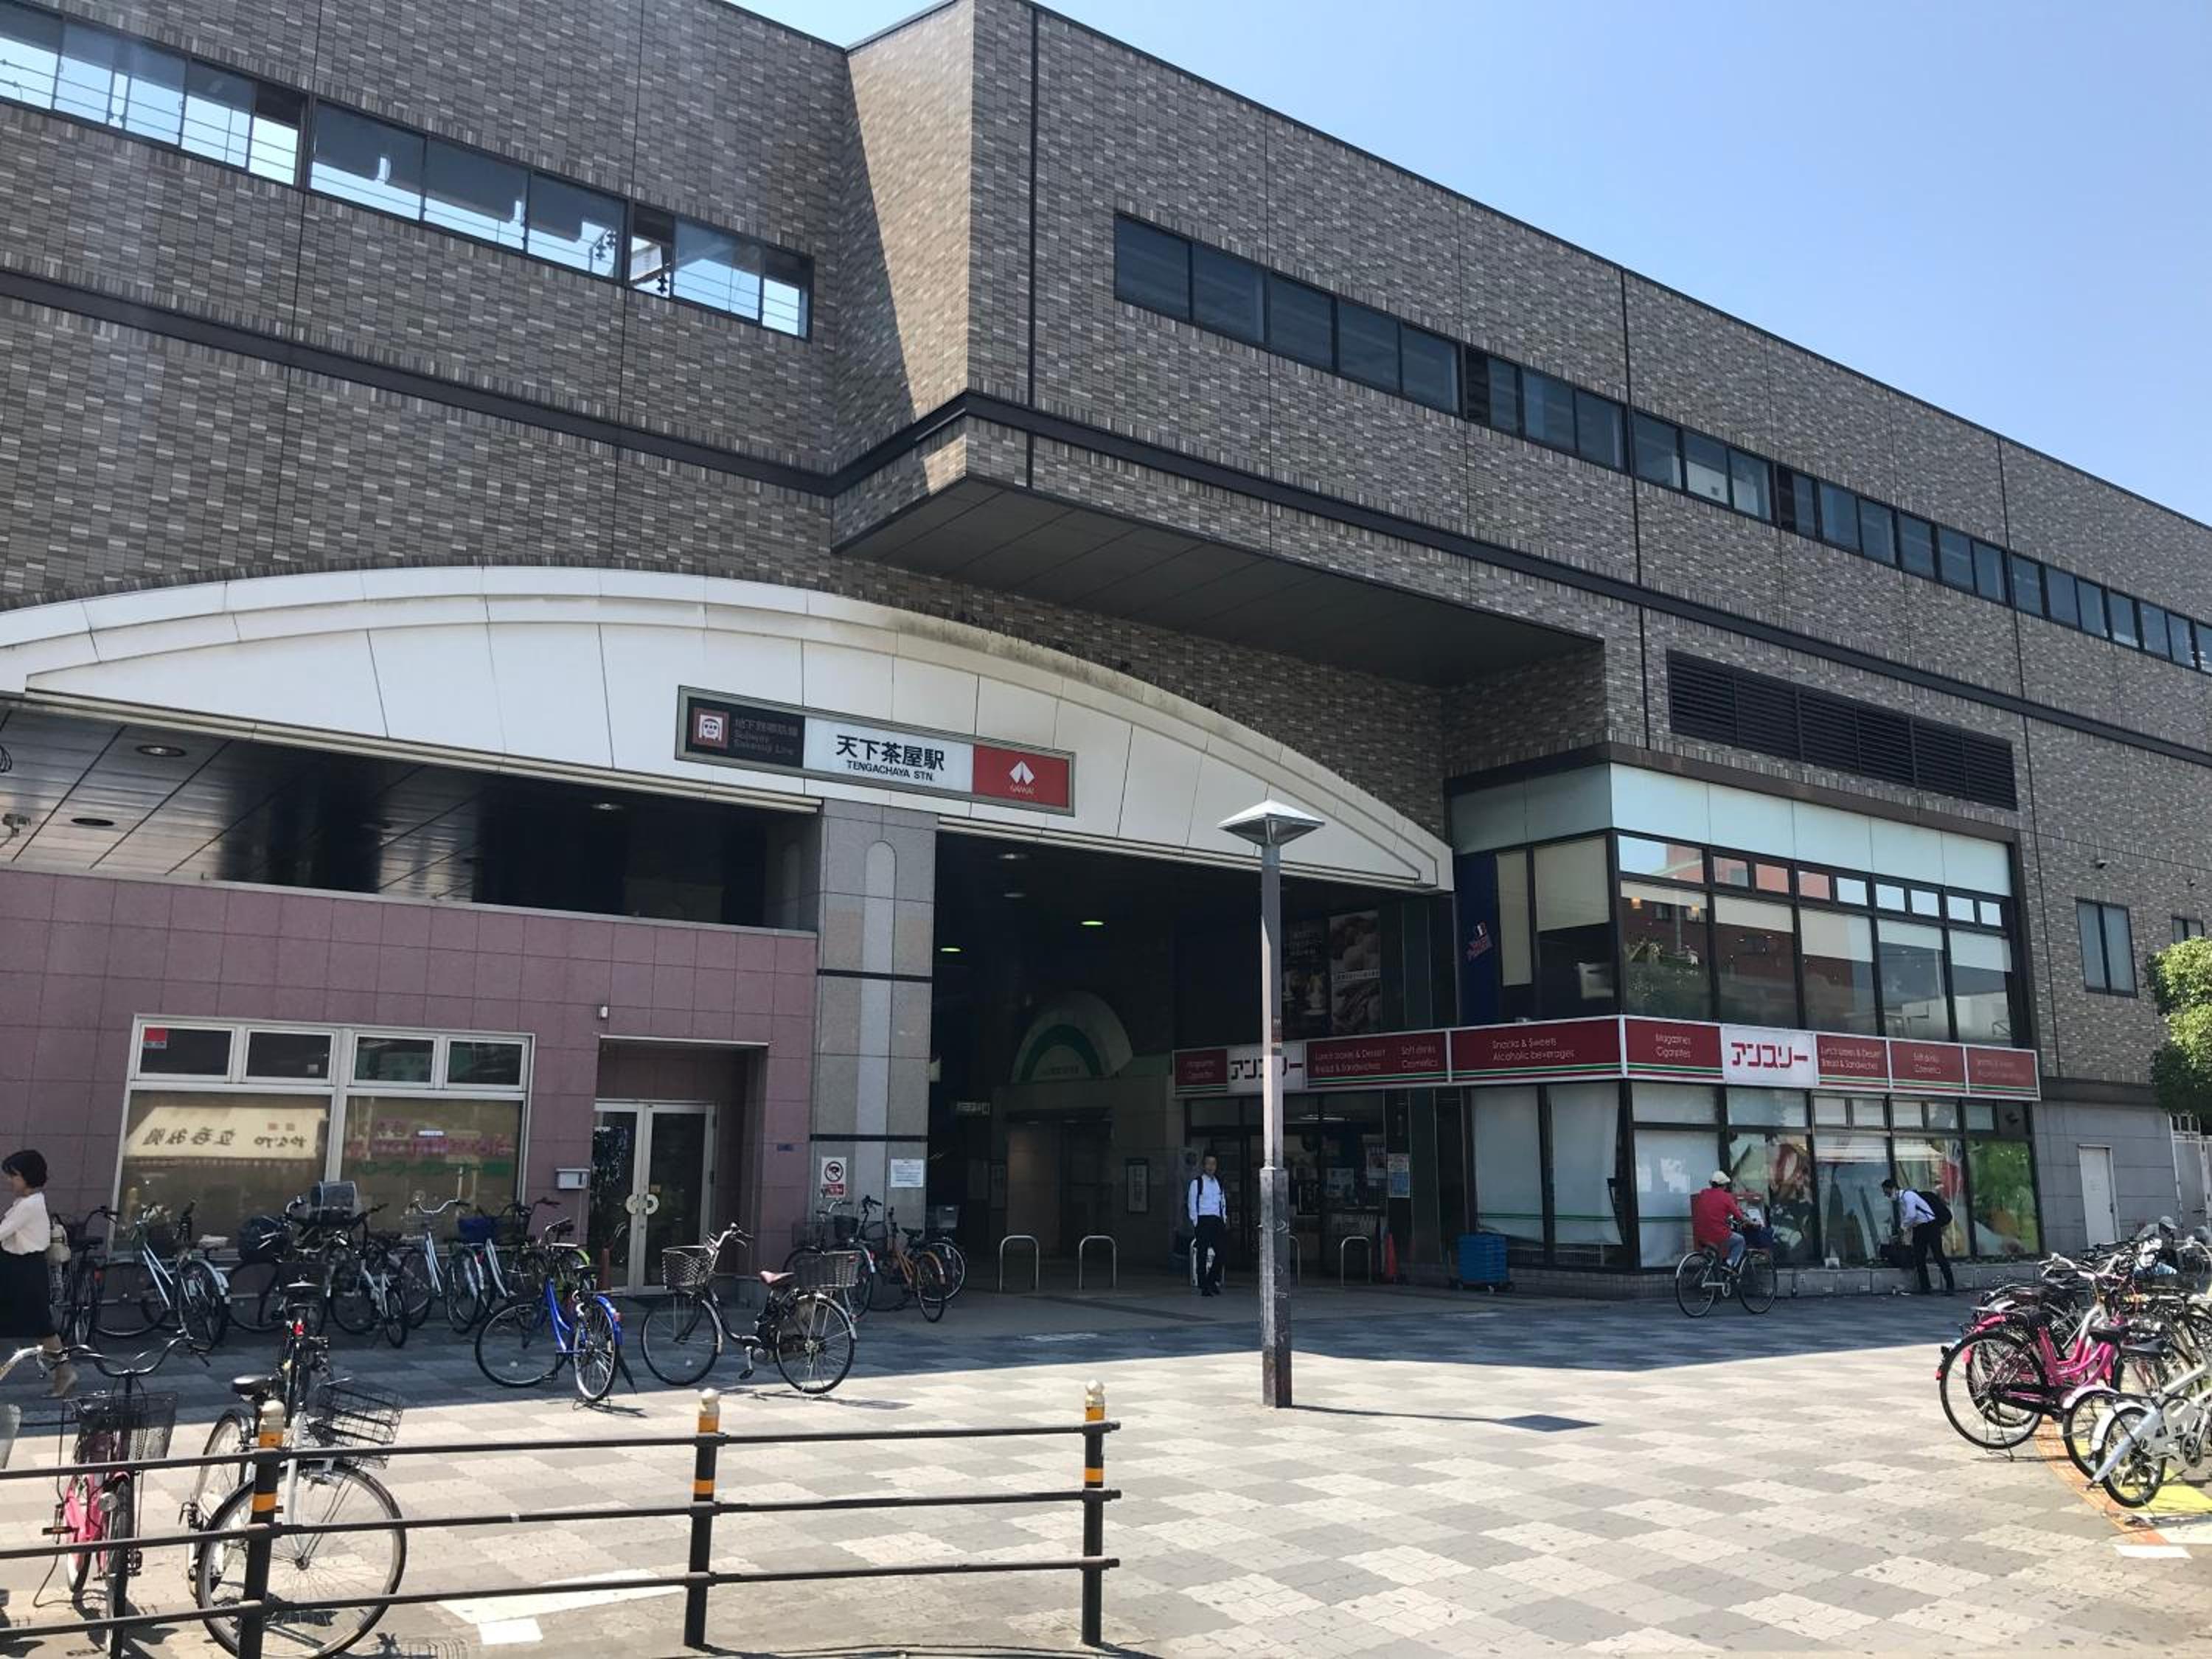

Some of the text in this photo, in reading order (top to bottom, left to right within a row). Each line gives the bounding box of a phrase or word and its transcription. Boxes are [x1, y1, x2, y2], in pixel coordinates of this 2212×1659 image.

[836, 735, 945, 771] 天下茶屋駅
[846, 759, 911, 778] TENGACHAYA
